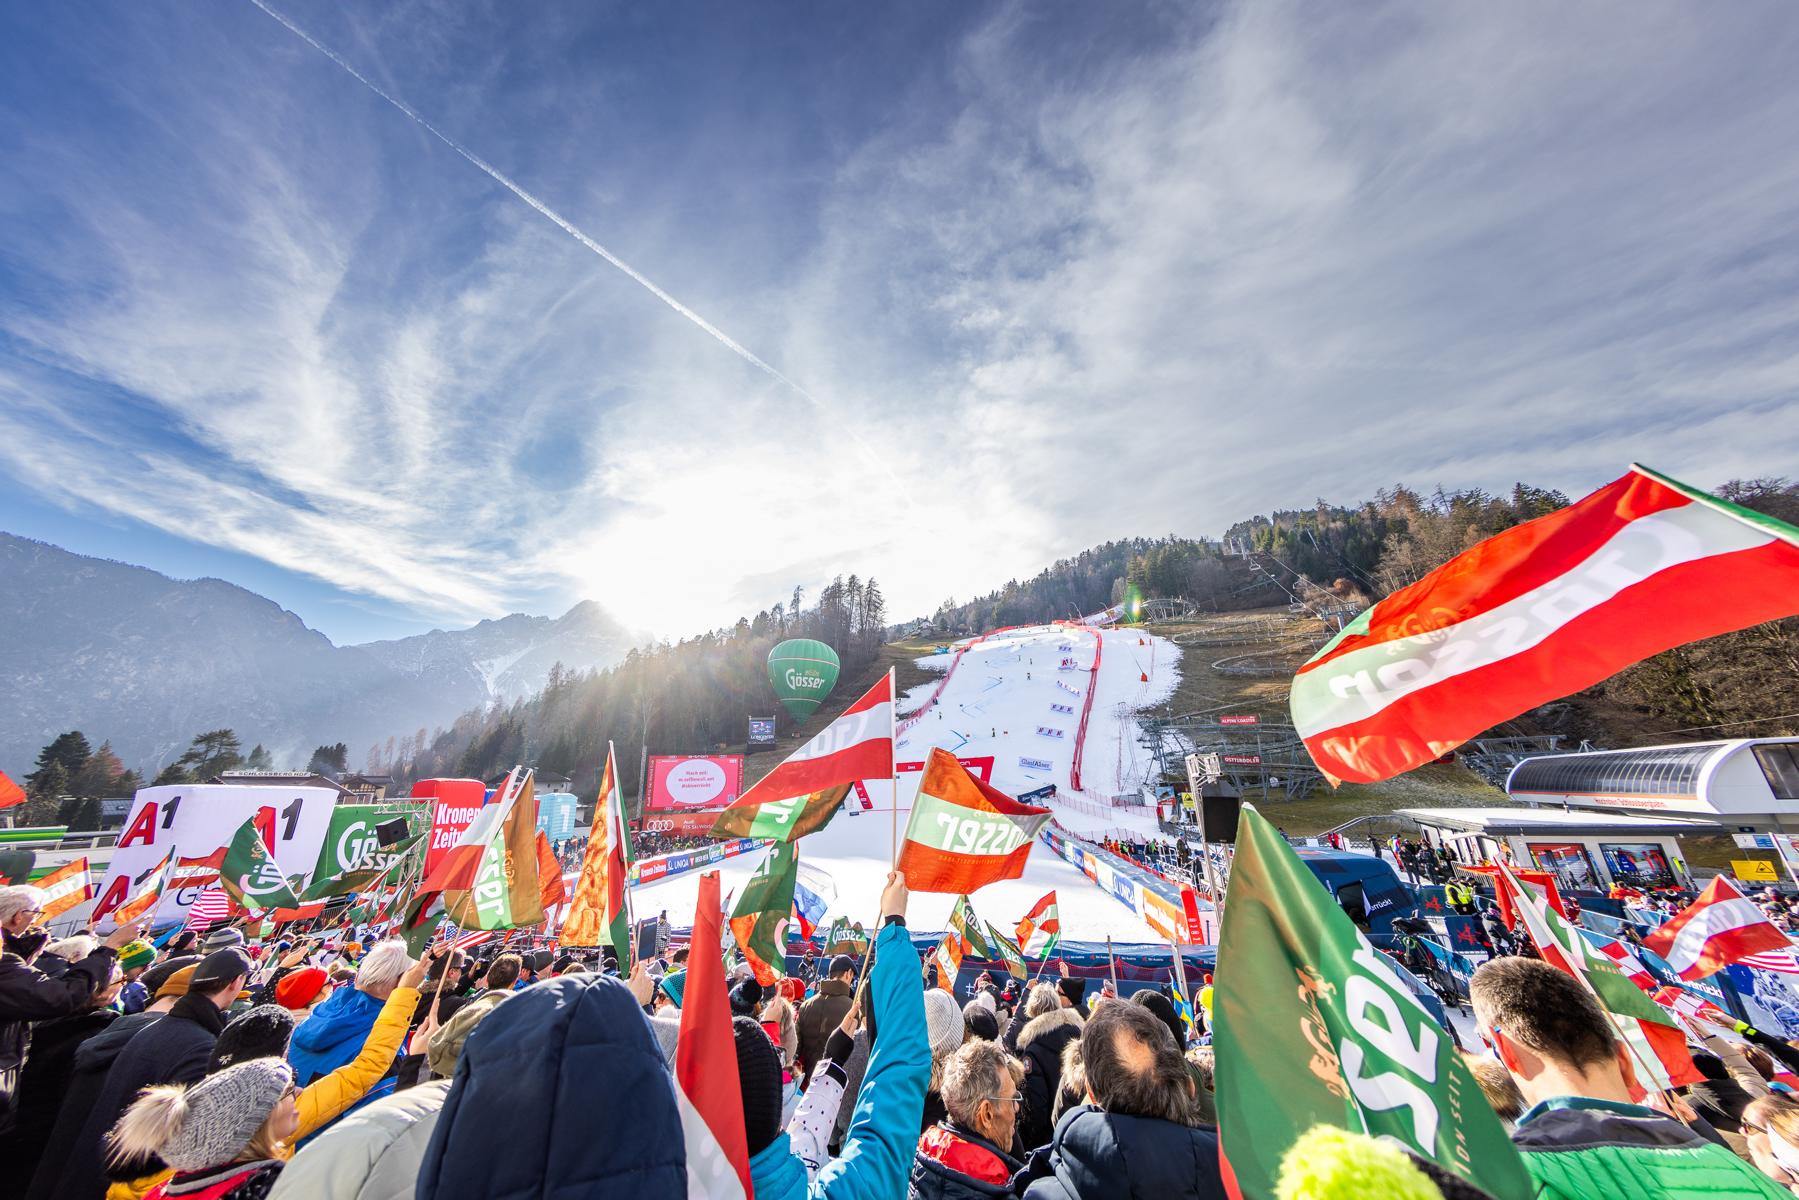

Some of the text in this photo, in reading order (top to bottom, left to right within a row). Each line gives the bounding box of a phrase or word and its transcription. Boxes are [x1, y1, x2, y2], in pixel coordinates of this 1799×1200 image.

[785, 668, 825, 690] Gösser
[117, 796, 181, 848] A1
[833, 925, 860, 945] Gösser
